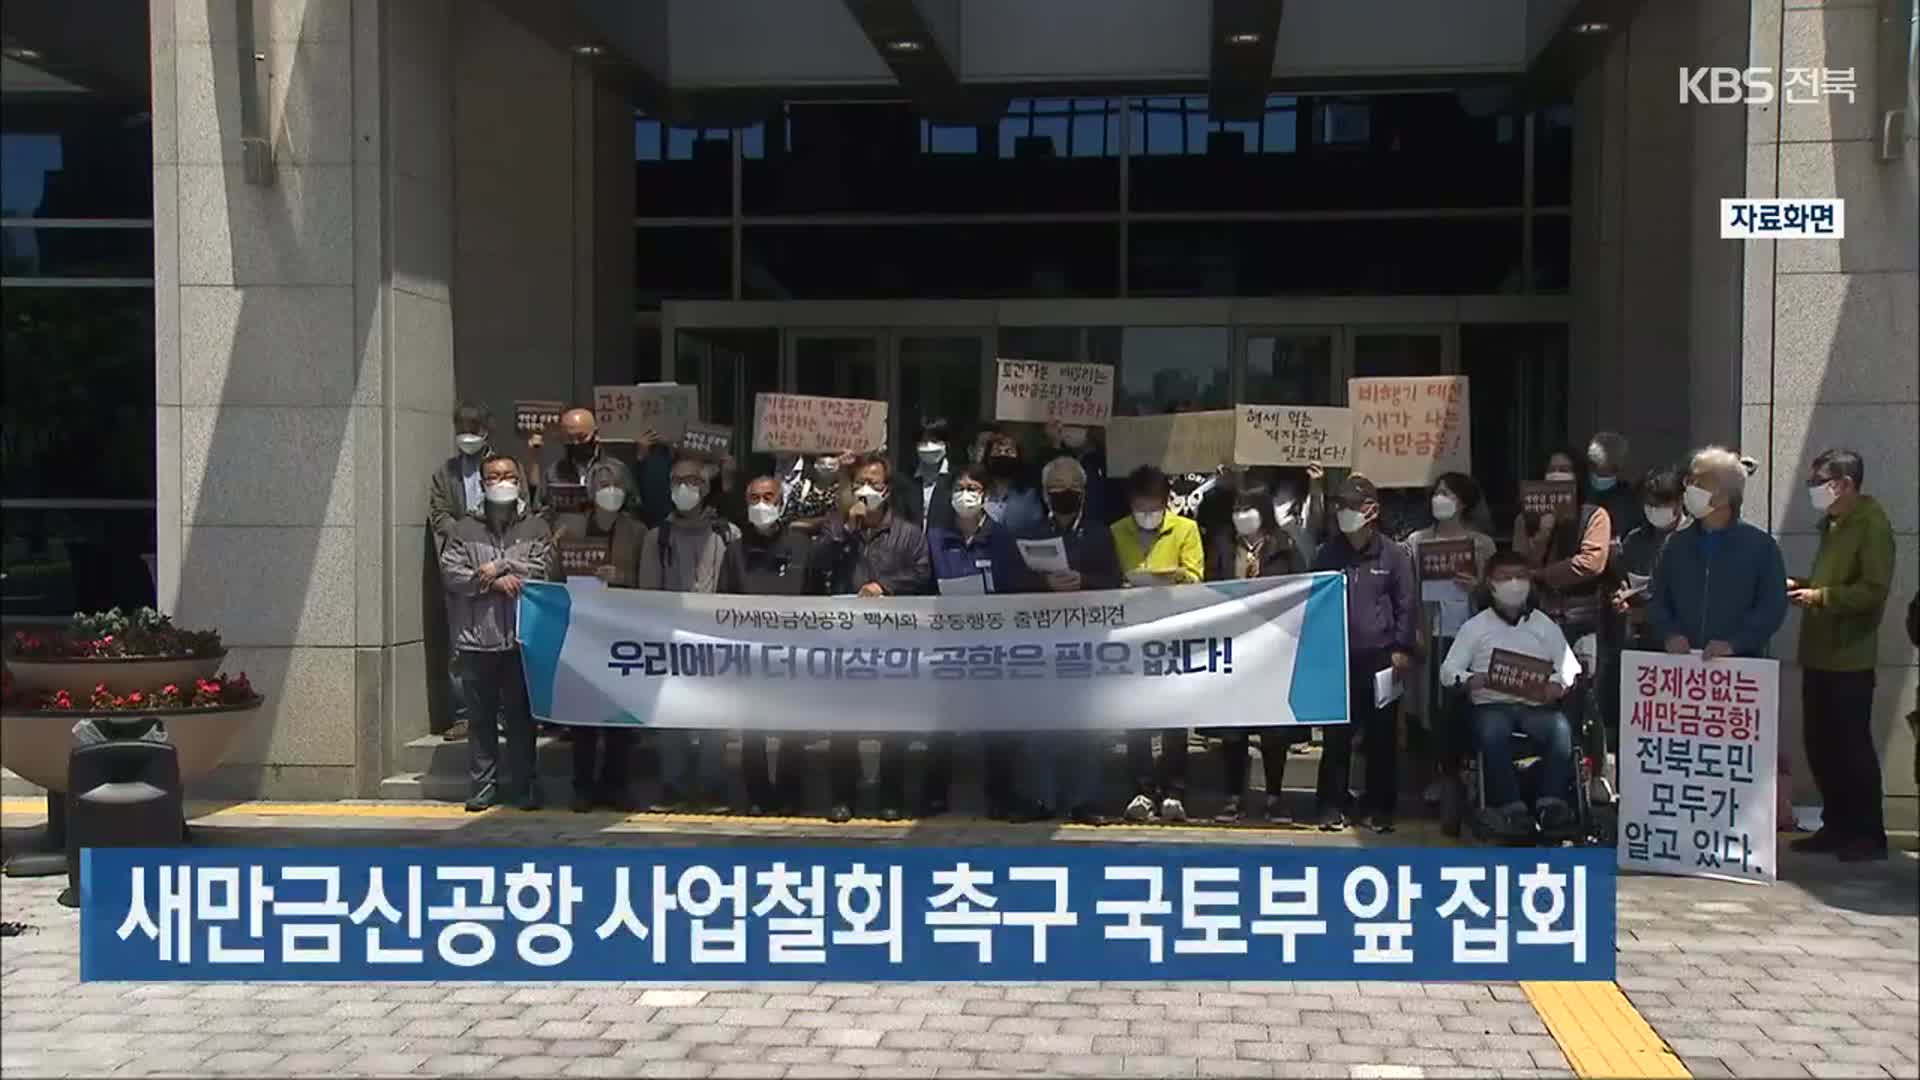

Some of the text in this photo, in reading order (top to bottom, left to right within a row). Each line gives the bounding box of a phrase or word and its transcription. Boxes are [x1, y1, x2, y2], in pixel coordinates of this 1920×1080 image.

[1358, 384, 1417, 407] 비행기
[608, 637, 1233, 680] 우리에게 더 이상의 공항은 필요 없다!
[1636, 665, 1759, 704] 경제성없는
[1631, 700, 1760, 742] 새만금공항!
[1636, 736, 1753, 783] 전북도민
[1648, 783, 1739, 828] 모두가
[1625, 822, 1763, 875] 알고 있다.
